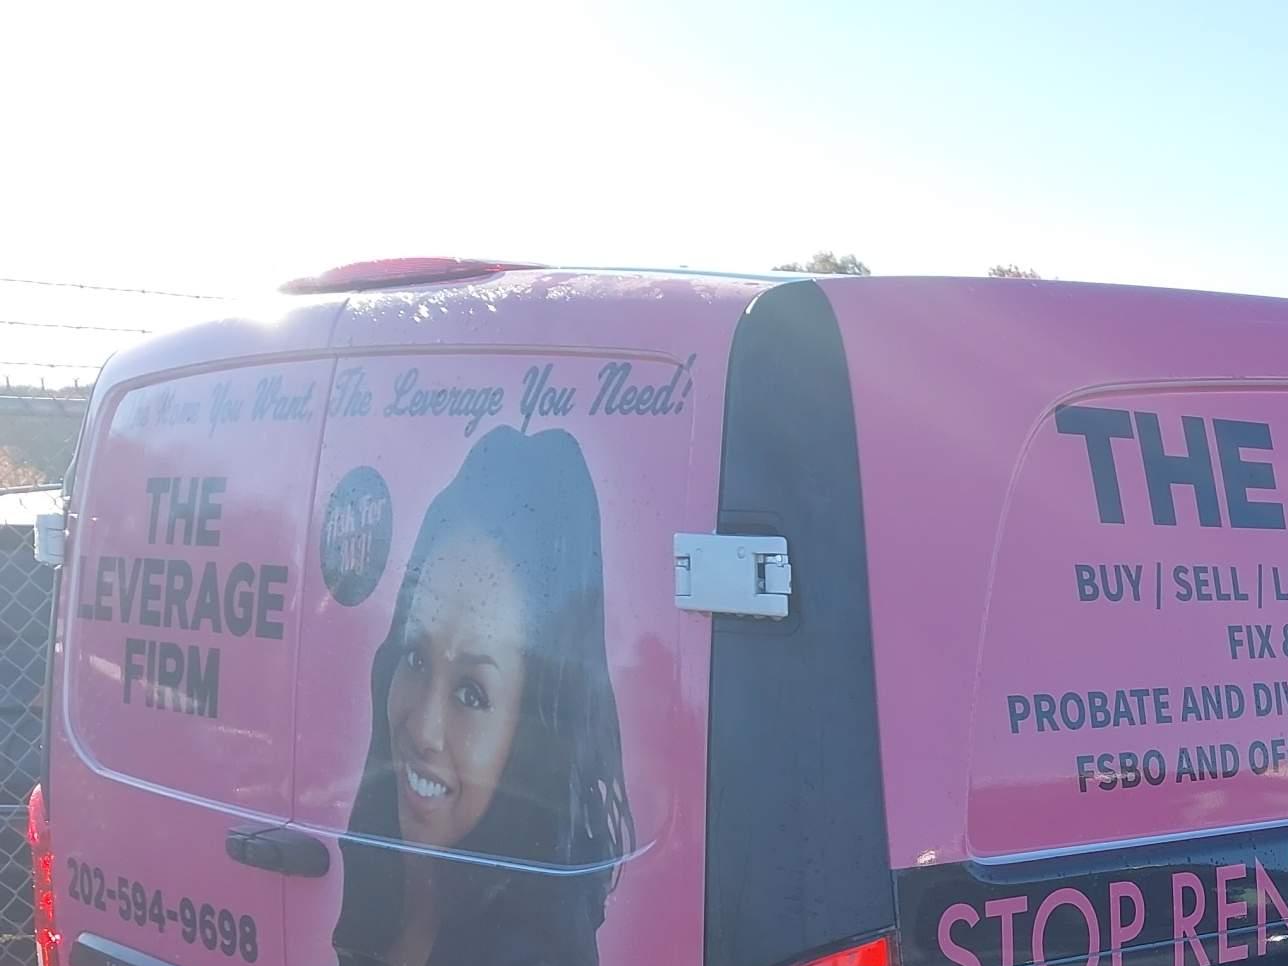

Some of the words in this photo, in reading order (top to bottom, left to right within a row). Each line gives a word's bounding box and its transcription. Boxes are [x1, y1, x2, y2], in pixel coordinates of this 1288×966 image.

[208, 380, 243, 440] You
[250, 374, 317, 424] Want,
[329, 366, 373, 418] The
[383, 367, 505, 438] Leverage
[518, 363, 577, 435] You
[588, 353, 697, 416] Need!
[1055, 404, 1286, 530] THE
[146, 477, 227, 547] THE
[77, 555, 289, 640] LEVERAGE
[1074, 564, 1143, 602] BUY
[1172, 565, 1249, 602] SELL
[123, 638, 221, 719] FIRM
[1228, 623, 1276, 660] FIX
[1007, 687, 1173, 734] PROBATE
[1181, 682, 1246, 722] AND
[1076, 749, 1166, 793] FSBO
[1175, 743, 1240, 783] AND
[67, 857, 259, 964] 202-594-9698
